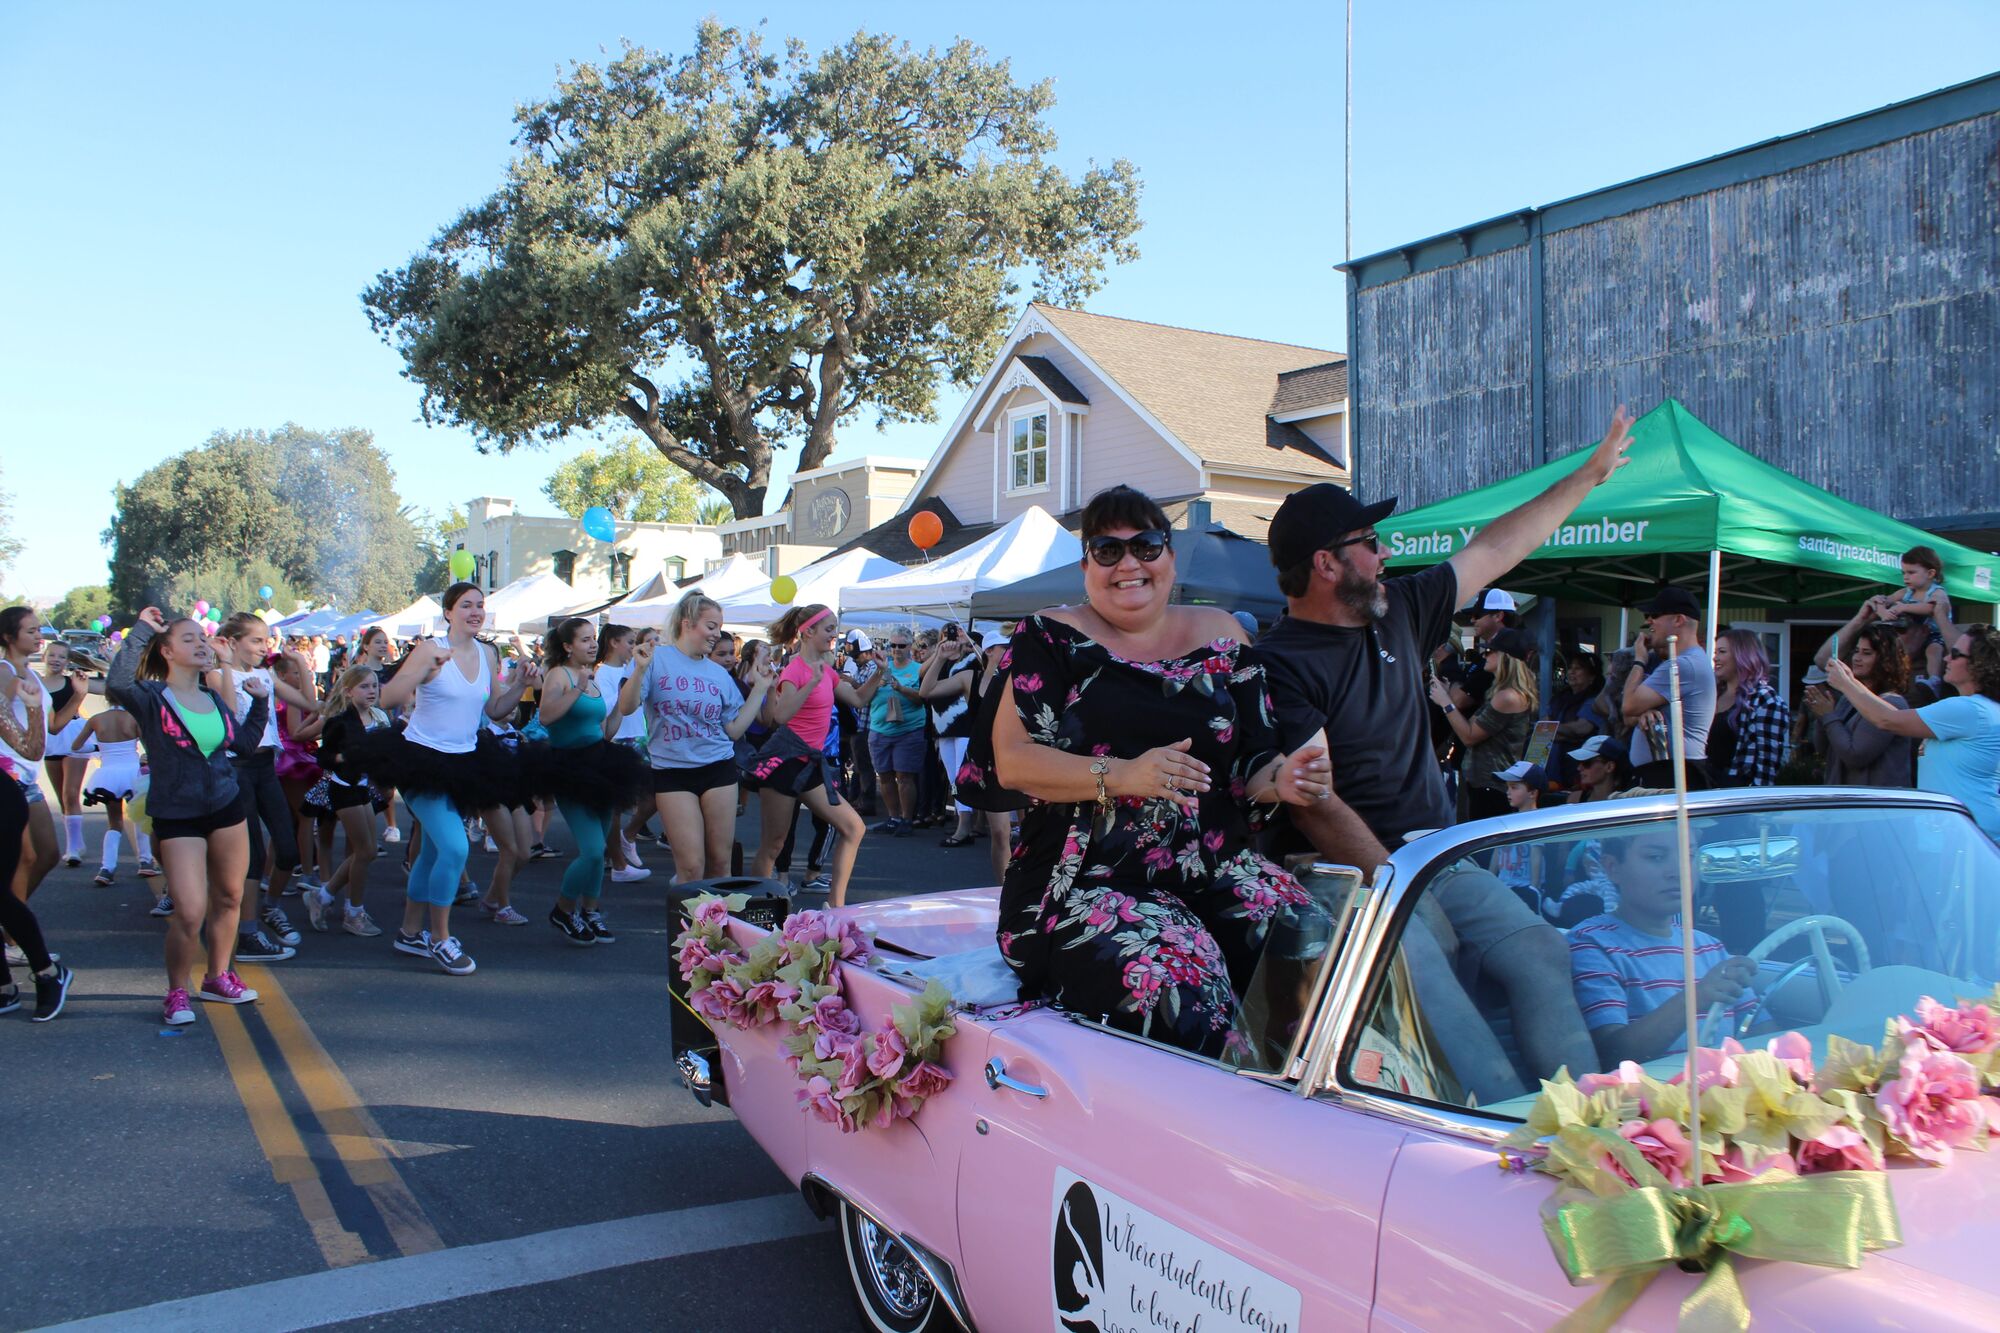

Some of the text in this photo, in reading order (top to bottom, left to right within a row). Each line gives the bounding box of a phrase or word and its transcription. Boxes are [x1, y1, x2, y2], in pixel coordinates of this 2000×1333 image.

[1391, 531, 1452, 556] Santa
[1544, 516, 1649, 547] hamber
[1104, 1203, 1157, 1269] Where
[1160, 1252, 1236, 1316] students
[1130, 1284, 1147, 1313] to
